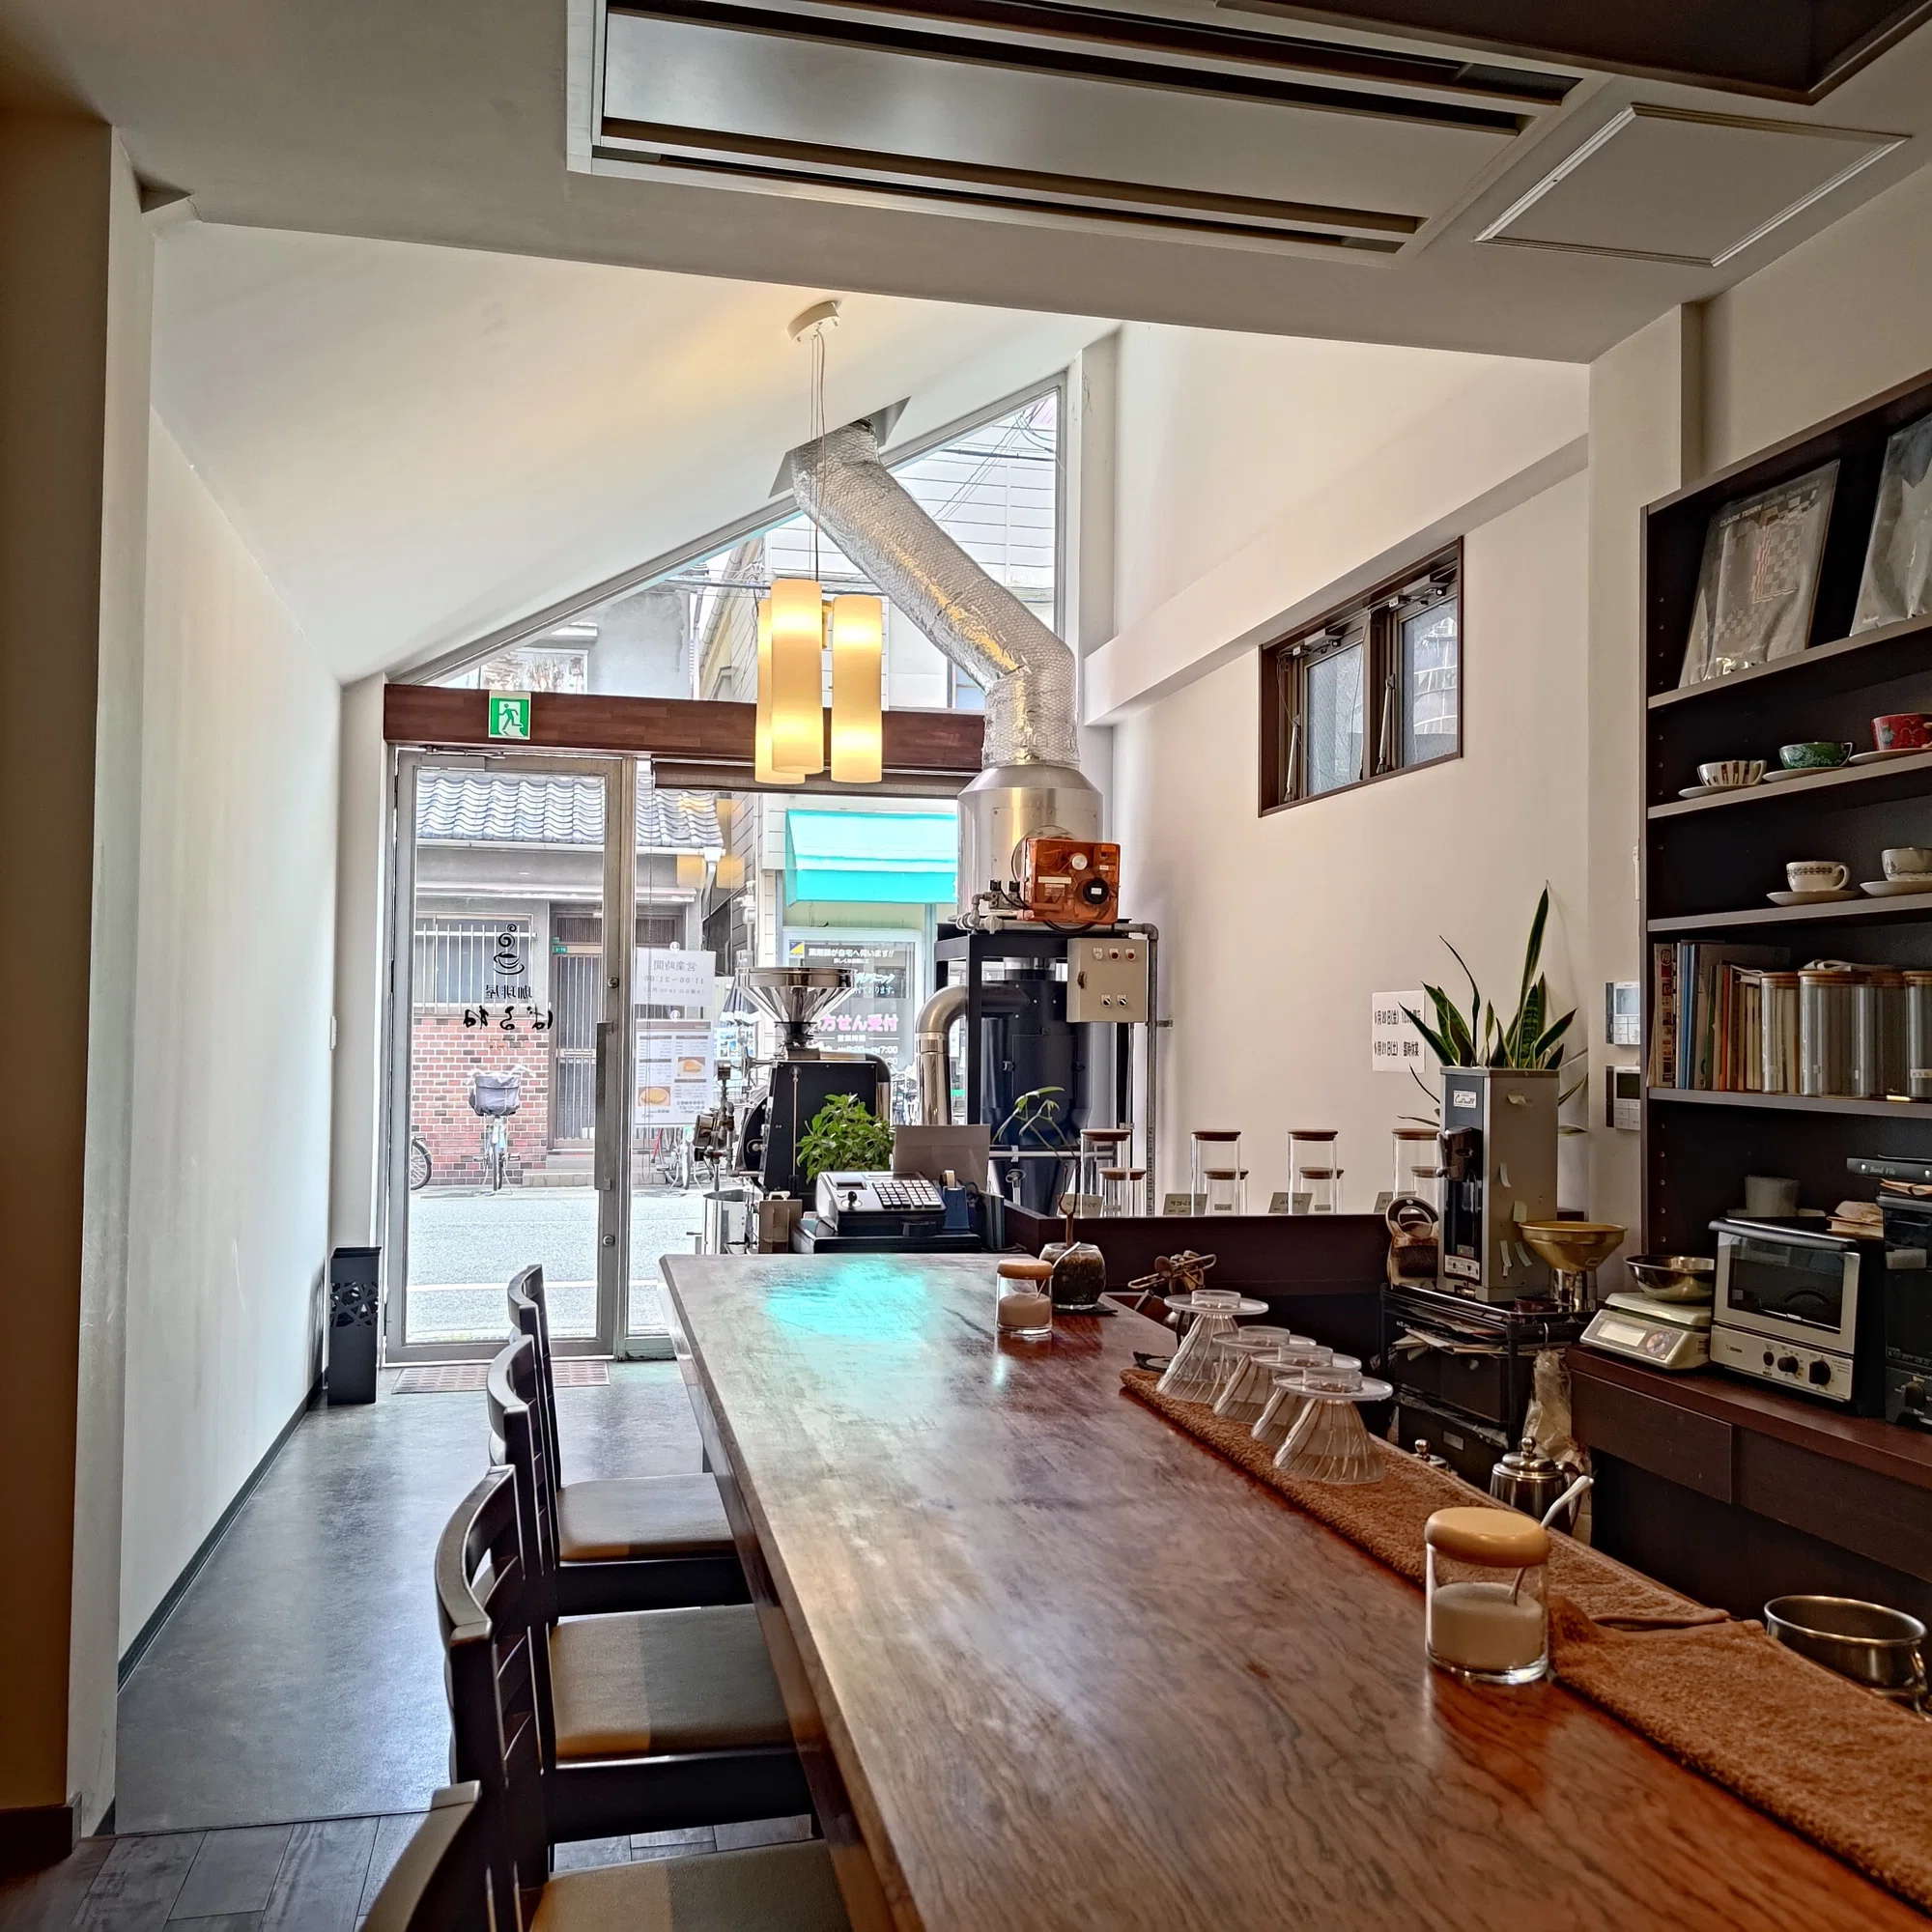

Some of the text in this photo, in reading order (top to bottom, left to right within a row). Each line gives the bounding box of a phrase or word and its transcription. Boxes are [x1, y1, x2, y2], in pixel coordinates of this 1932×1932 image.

[819, 1013, 899, 1032] 方せん受付
